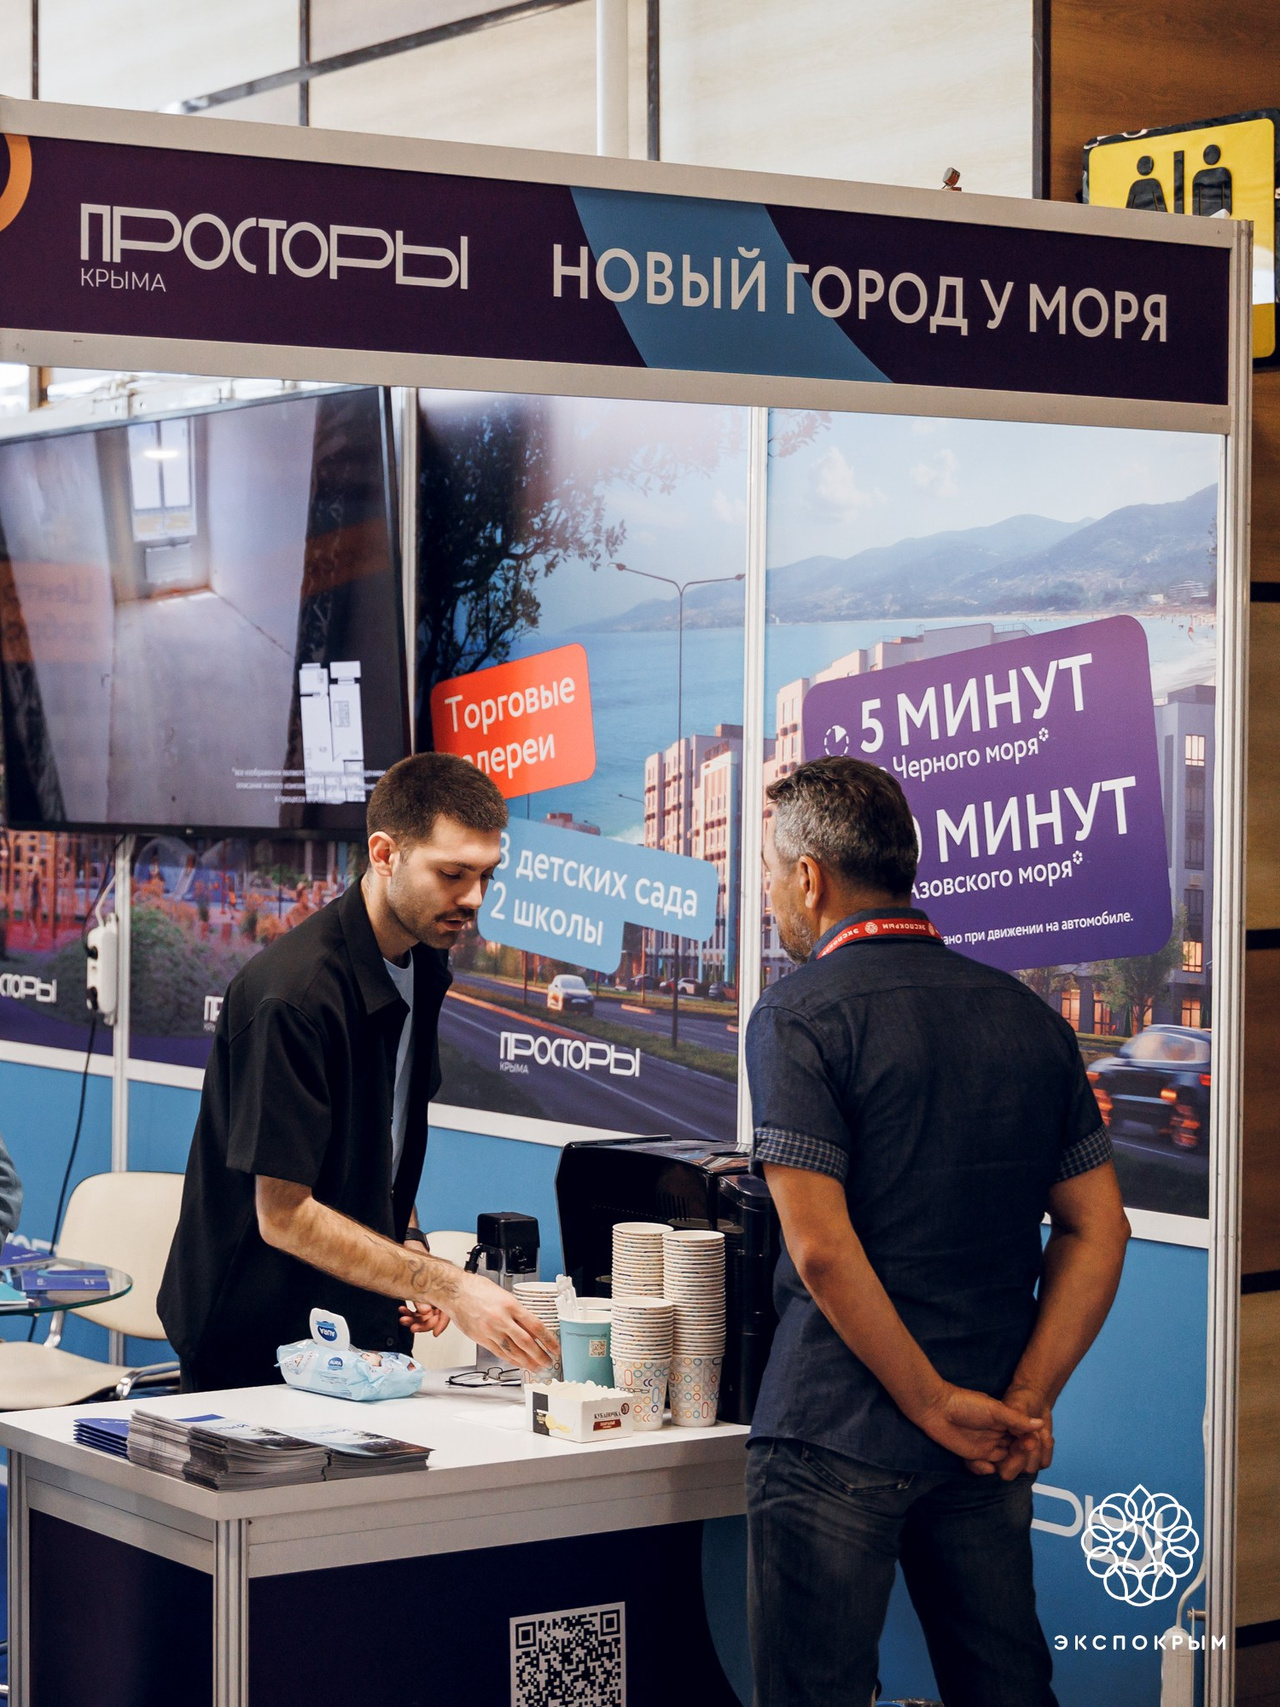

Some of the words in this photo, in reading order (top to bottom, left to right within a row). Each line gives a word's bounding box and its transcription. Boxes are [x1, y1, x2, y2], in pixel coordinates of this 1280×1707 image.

[80, 203, 468, 291] ПРОСТОРЫ
[553, 243, 766, 312] НОВЫЙ
[786, 263, 969, 336] ГОРОД
[980, 279, 1014, 330] У
[1029, 283, 1168, 343] МОРЯ
[81, 268, 166, 293] КРЫМА
[444, 677, 576, 735] Торговые
[860, 698, 884, 754] 5
[896, 653, 1093, 746] МИНУТ
[461, 733, 556, 780] лереи
[892, 745, 980, 782] Черного
[936, 776, 1136, 863] МИНУТ
[516, 848, 628, 899] детских
[634, 878, 698, 918] сада
[490, 881, 507, 920] 2
[513, 897, 603, 946] школы
[964, 931, 986, 945] при
[987, 924, 1044, 941] движении
[1046, 921, 1060, 932] на
[1061, 910, 1134, 930] автомобиле.
[499, 1061, 529, 1075] КРЫМА
[500, 1031, 641, 1077] ПРОСТОРЫ
